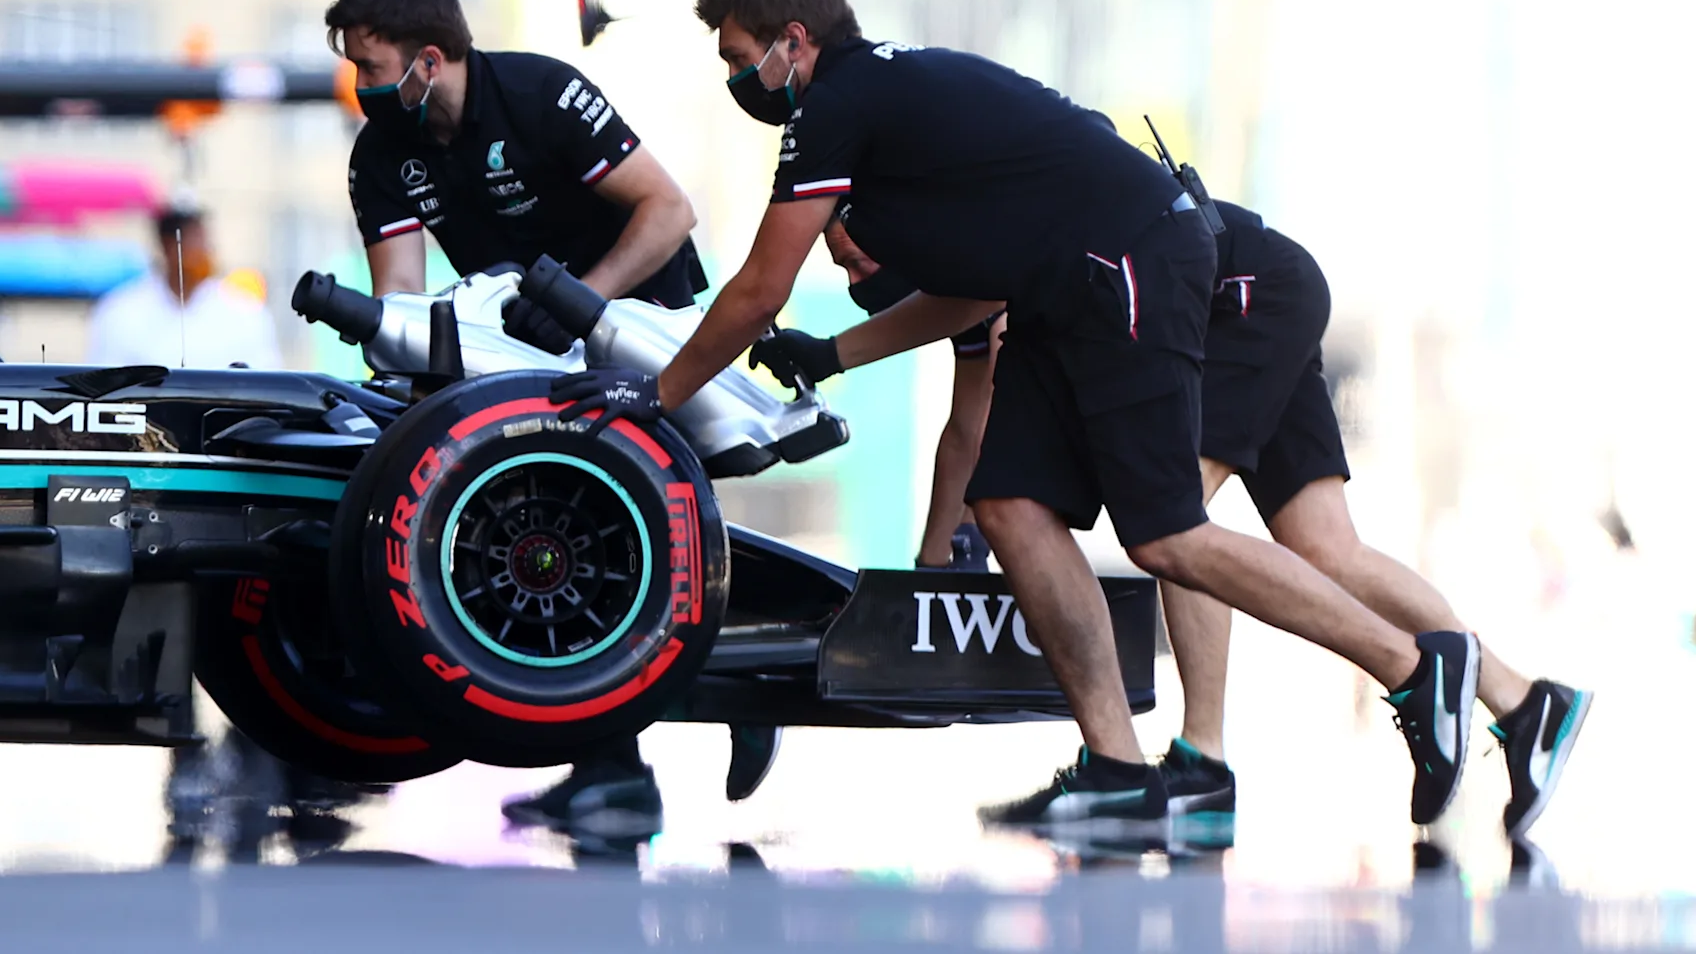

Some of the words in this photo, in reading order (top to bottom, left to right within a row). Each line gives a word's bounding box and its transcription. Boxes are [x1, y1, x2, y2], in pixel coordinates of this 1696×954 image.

[605, 385, 641, 401] HyFlex
[385, 445, 443, 629] ZERO
[665, 482, 703, 625] PIRELLI
